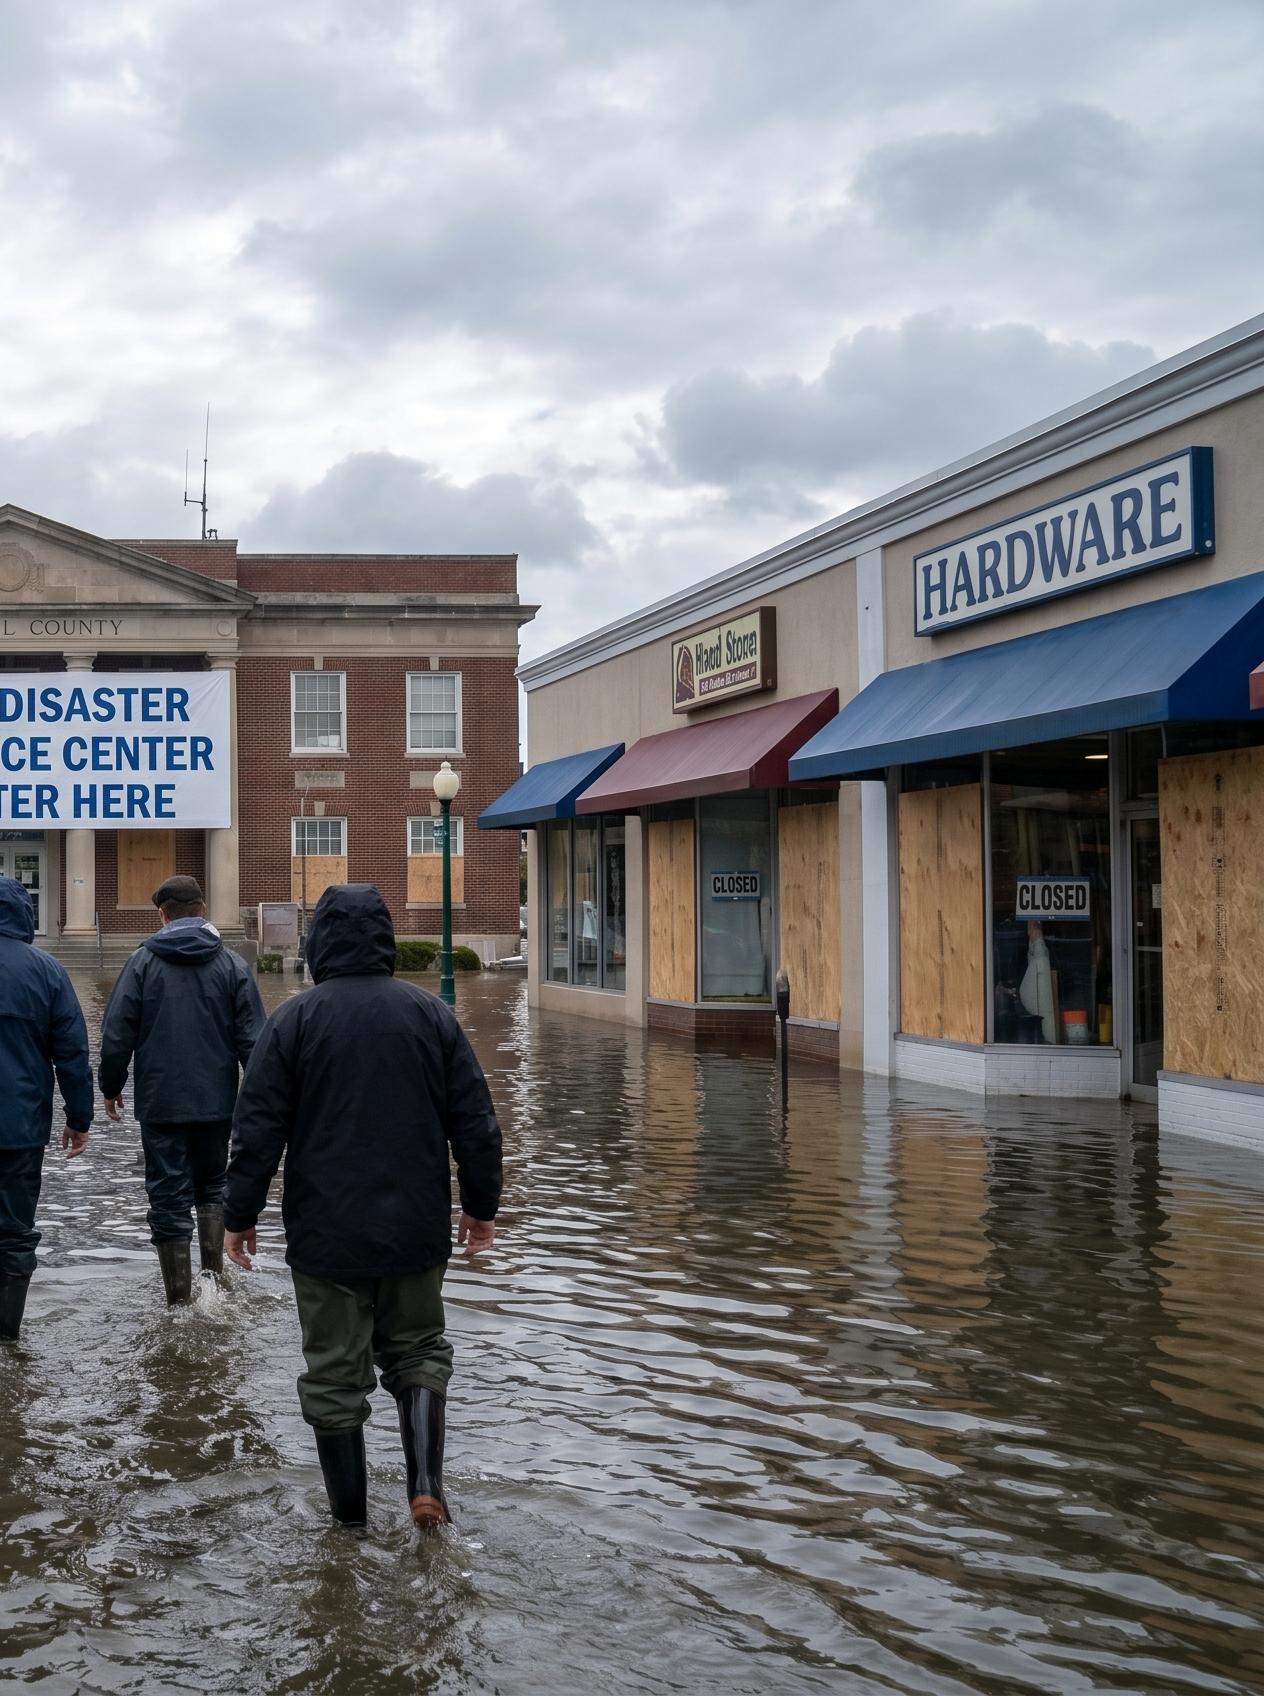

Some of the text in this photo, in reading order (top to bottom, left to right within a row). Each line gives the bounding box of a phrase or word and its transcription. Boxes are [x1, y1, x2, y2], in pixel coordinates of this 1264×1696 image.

[922, 470, 1183, 621] HARDWARE
[30, 619, 124, 636] COUNTY
[62, 736, 215, 772] CENTER
[73, 783, 176, 819] HERE
[713, 876, 758, 894] CLOSED
[1019, 884, 1087, 911] CLOSED
